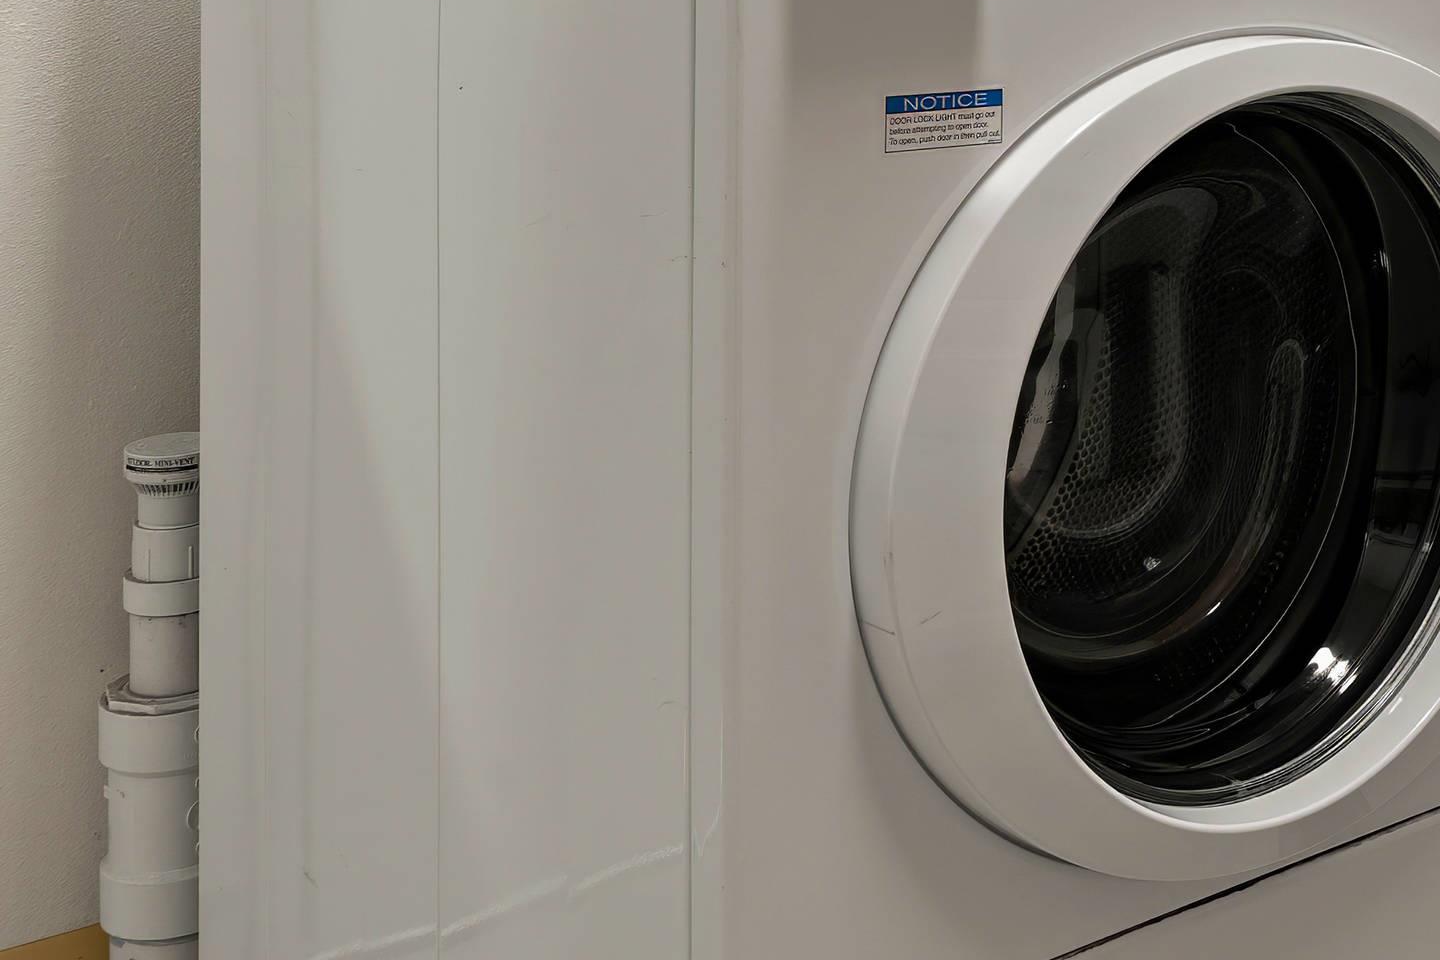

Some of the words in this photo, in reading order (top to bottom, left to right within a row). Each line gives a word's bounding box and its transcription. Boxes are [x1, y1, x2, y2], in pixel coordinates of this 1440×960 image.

[904, 93, 988, 111] NOTICE
[890, 116, 912, 125] DOOR
[914, 114, 934, 124] LOCK
[936, 113, 956, 122] LIGHT
[958, 112, 974, 120] must
[889, 127, 911, 136] before
[912, 124, 946, 134] attempting
[919, 135, 936, 144] push
[937, 133, 952, 141] door
[961, 131, 976, 140] then
[976, 130, 988, 139] pull
